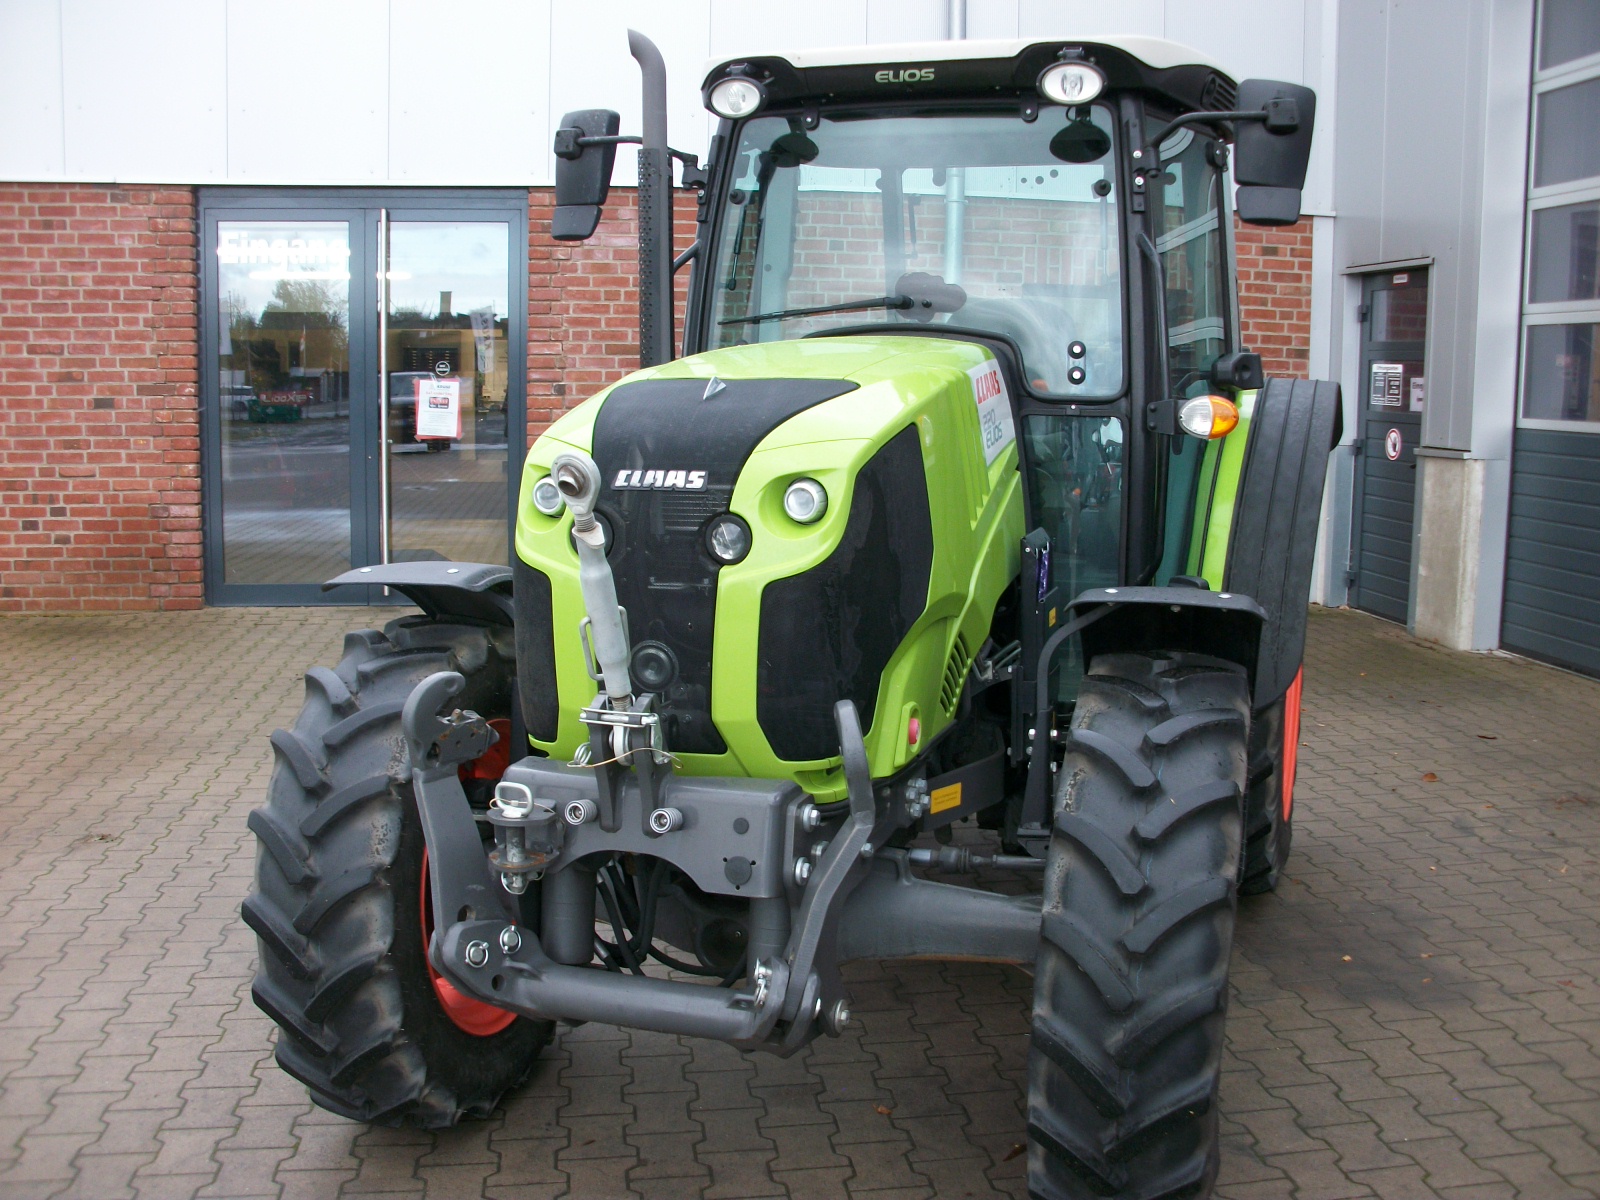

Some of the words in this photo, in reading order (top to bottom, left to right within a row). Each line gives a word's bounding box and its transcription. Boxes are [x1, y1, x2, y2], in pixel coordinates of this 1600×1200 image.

[875, 68, 935, 83] ELIOS
[975, 369, 1001, 405] CLAAS
[985, 420, 1003, 449] ELIOS
[614, 470, 706, 489] CLAAS
